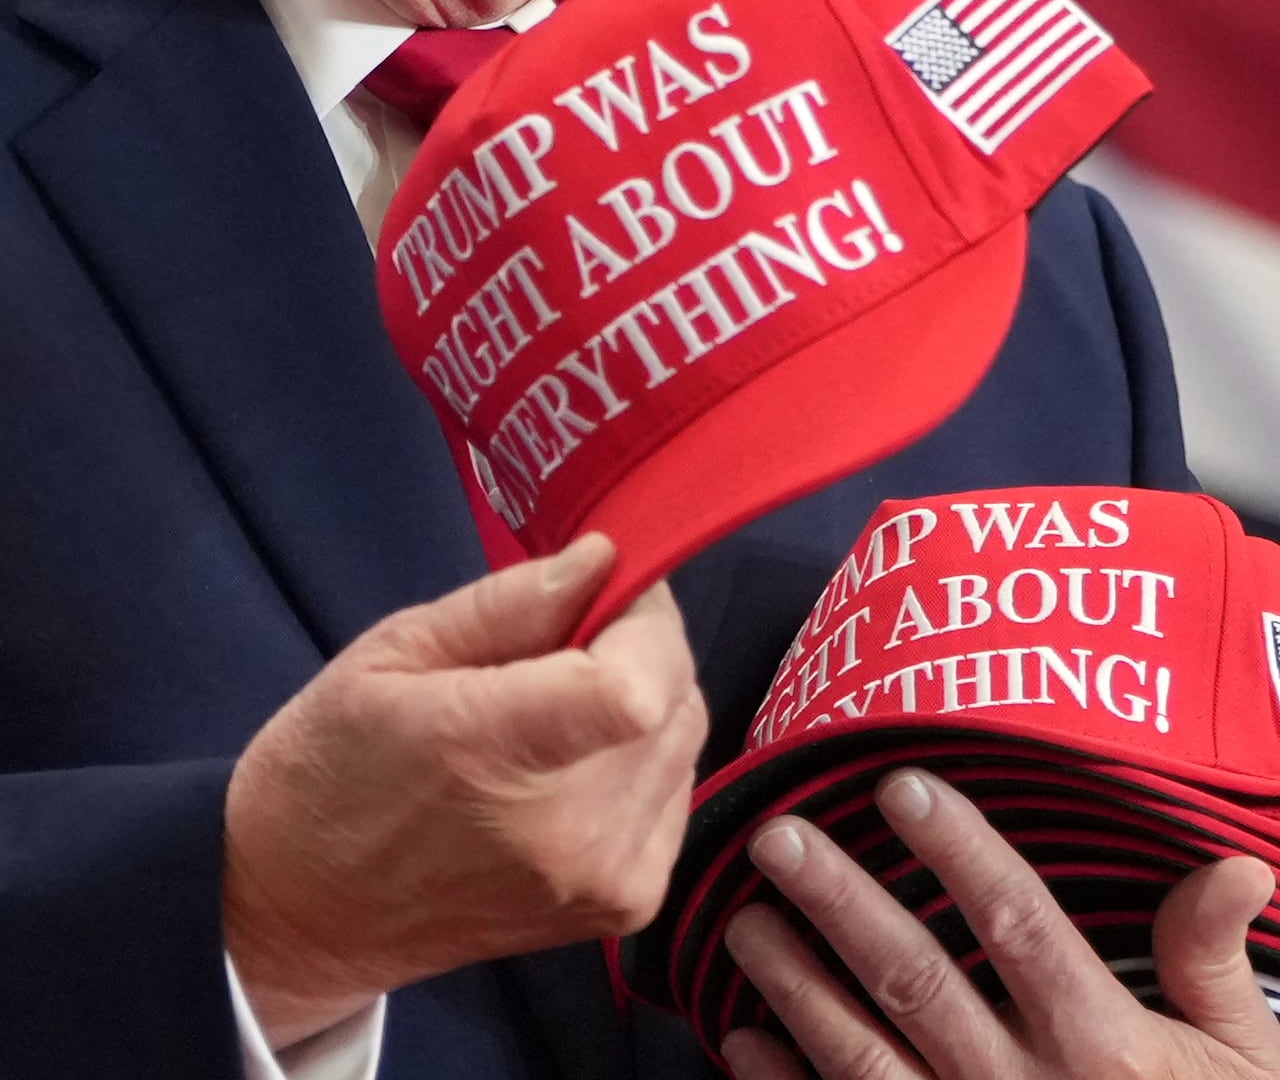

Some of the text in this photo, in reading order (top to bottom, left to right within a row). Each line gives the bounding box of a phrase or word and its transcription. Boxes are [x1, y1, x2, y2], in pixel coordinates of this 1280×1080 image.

[391, 2, 752, 317] TRUMP WAS
[422, 79, 839, 427] RIGHT ABOUT
[488, 179, 904, 526] VERYTHING!
[883, 568, 1175, 650] ABOUT
[949, 499, 1130, 554] WAS
